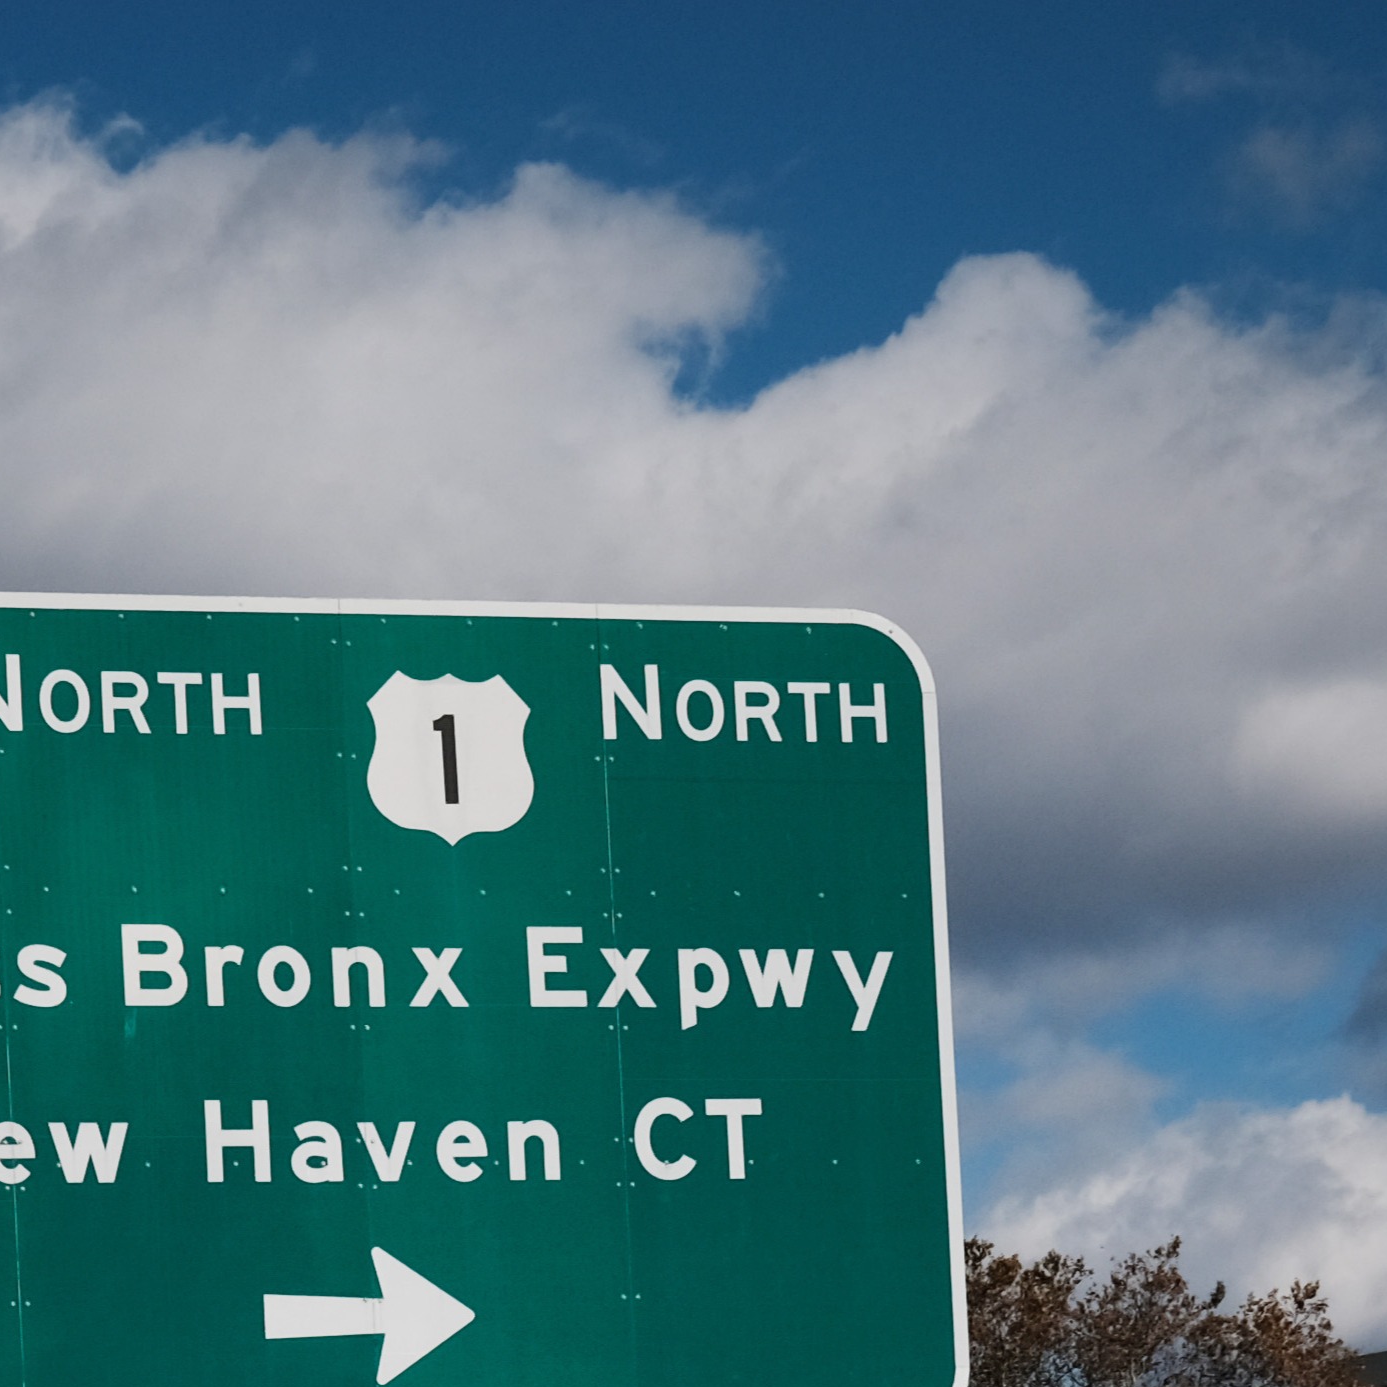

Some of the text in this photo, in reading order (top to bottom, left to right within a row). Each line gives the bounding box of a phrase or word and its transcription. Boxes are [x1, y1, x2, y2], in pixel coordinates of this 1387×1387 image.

[601, 664, 887, 742] NORTH
[432, 713, 460, 805] 1
[122, 924, 468, 1007] Bronx
[527, 927, 892, 1031] Expwy
[205, 1100, 560, 1183] Haven
[635, 1098, 762, 1181] CT
